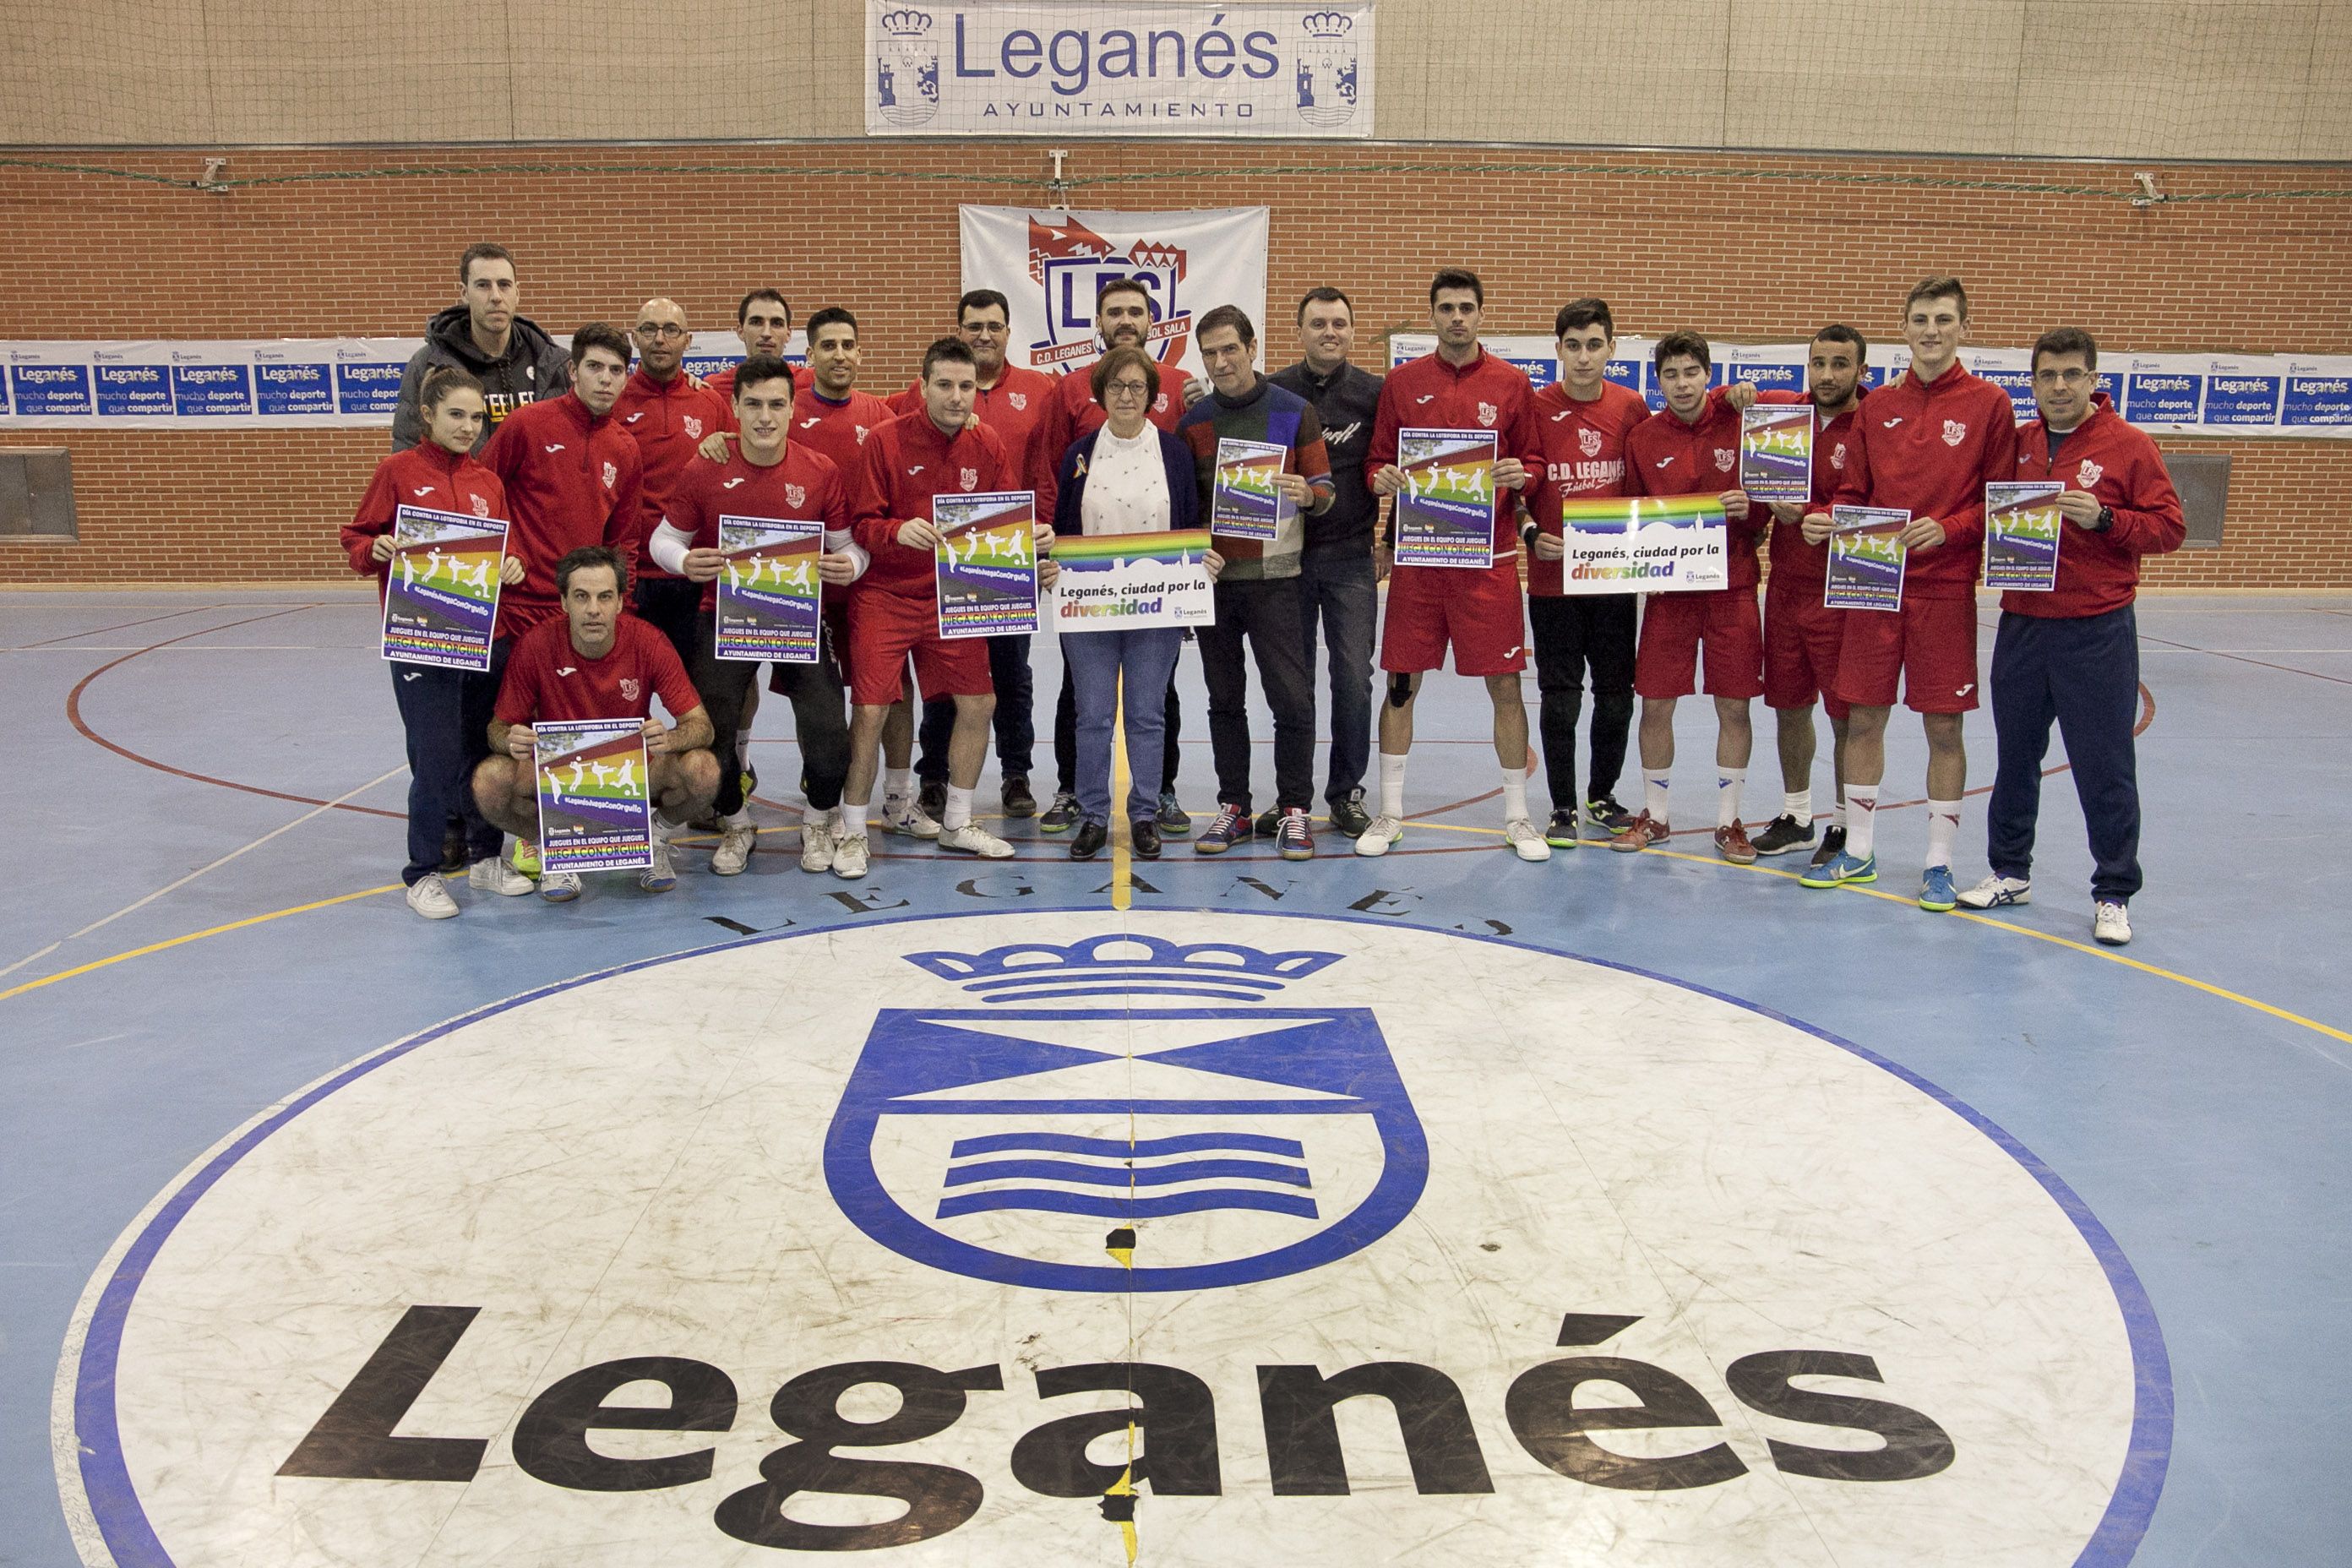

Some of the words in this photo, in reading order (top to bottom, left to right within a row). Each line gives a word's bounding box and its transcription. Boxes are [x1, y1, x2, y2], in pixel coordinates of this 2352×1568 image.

[956, 14, 1279, 95] Leganés
[983, 103, 1252, 117] AYUNTAMIENTO
[1037, 351, 1053, 364] C.D.
[1054, 342, 1092, 359] LEGANES
[1164, 322, 1186, 336] SALA
[19, 367, 77, 384] Leganés
[101, 368, 160, 384] Leganés
[181, 367, 238, 384] Leganés
[262, 366, 321, 383] Leganés
[344, 365, 402, 382] Leganés
[1737, 365, 1794, 382] Leganés
[2136, 377, 2191, 392] Leganés
[2214, 378, 2269, 394] Leganés
[2293, 378, 2349, 395] Leganés
[47, 391, 84, 401] deporte
[129, 391, 166, 401] deporte
[208, 391, 244, 400] deporte
[290, 390, 325, 400] deporte
[46, 404, 91, 414] compartir
[128, 404, 173, 414] compartir
[206, 404, 252, 414] compartir
[288, 403, 334, 412] compartir
[2158, 399, 2193, 410] deporte
[2236, 401, 2271, 411] deporte
[2315, 403, 2349, 412] deporte
[2137, 412, 2151, 421] que
[2154, 411, 2197, 422] compartir
[2232, 413, 2275, 423] compartir
[1947, 426, 1963, 434] LFS
[1583, 435, 1598, 444] LFS
[1548, 463, 1574, 482] C.D.
[1398, 544, 1425, 553] JUEGA
[1428, 545, 1448, 554] CON
[1451, 547, 1490, 555] ORGULLO
[1572, 547, 1630, 561] Leganés,
[1633, 546, 1677, 558] ciudad
[1680, 547, 1703, 558] por
[1707, 544, 1719, 554] la
[1571, 561, 1674, 580] diversidad
[1060, 585, 1118, 600] Leganés,
[1121, 582, 1165, 595] ciudad
[1168, 581, 1190, 594] por
[1194, 580, 1206, 591] la
[1060, 597, 1162, 618] diversidad
[941, 617, 971, 625] JUEGA
[973, 615, 994, 623] CON
[997, 612, 1037, 622] ORGULLO
[390, 627, 413, 636] JUEGUES
[429, 631, 449, 640] EQUIPO
[450, 634, 461, 642] QUE
[462, 635, 485, 645] JUEGUES
[948, 626, 995, 634] AYUNTAMIENTO
[384, 636, 416, 649] JUEGA
[419, 640, 441, 651] CON
[445, 642, 488, 657] ORGULLO
[718, 637, 748, 646] JUEGA
[751, 638, 772, 648] CON
[776, 640, 817, 650] ORGULLO
[389, 651, 442, 663] AYUNTAMIENTO
[453, 658, 482, 667] LEGANÉS
[549, 839, 572, 847] JUEGUES
[545, 849, 577, 860] JUEGA
[580, 847, 603, 858] CON
[607, 844, 650, 855] ORGULLO
[552, 859, 604, 870] AYUNTAMIENTO
[616, 857, 645, 865] LEGANÉS
[275, 1305, 1956, 1550] Leganés
